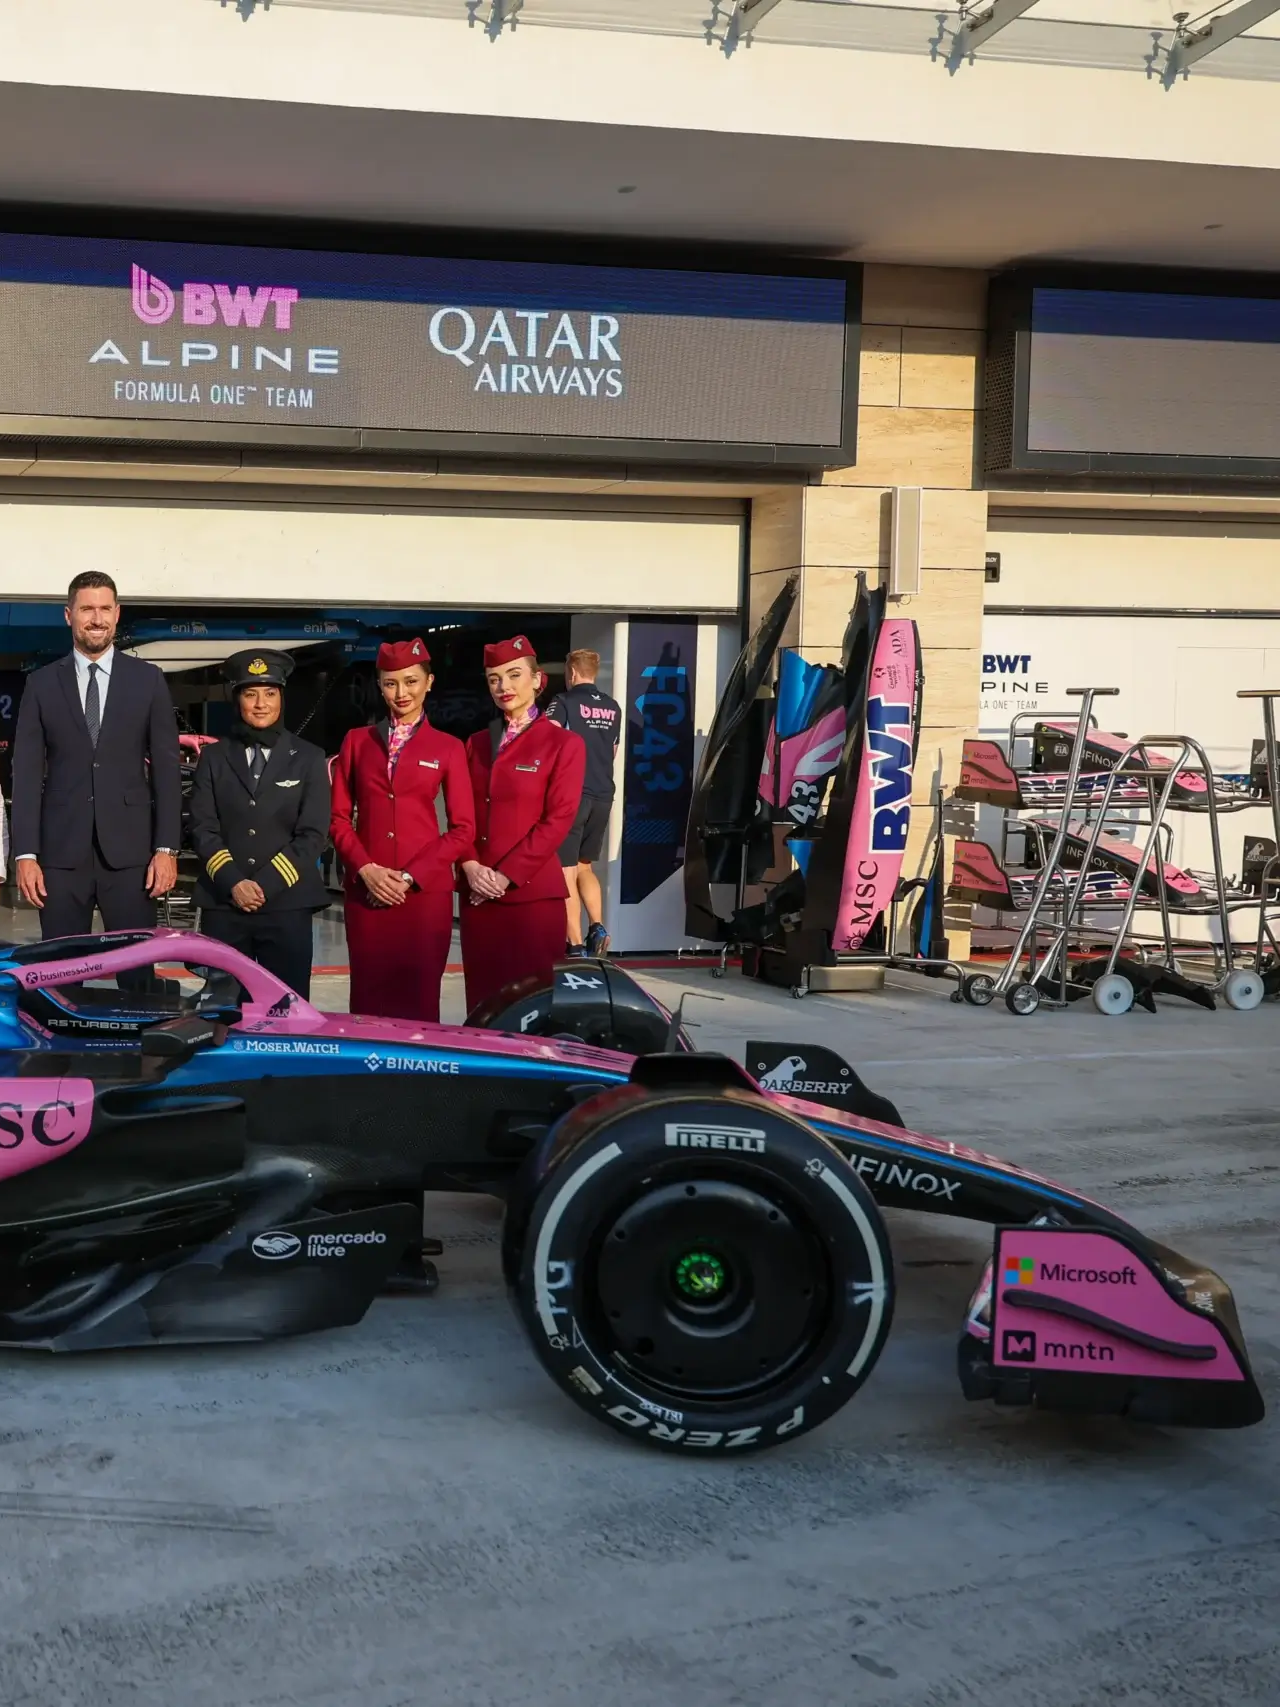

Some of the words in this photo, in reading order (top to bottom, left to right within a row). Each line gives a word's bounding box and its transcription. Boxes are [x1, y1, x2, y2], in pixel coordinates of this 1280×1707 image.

[182, 283, 299, 330] BWT
[428, 307, 622, 367] QATAR
[88, 339, 339, 374] ALPINE
[474, 363, 624, 398] AIRWAYS
[114, 381, 201, 404] FORMULA
[265, 386, 314, 408] TEAM
[171, 623, 191, 633] eni
[304, 623, 323, 633] eni
[982, 654, 1032, 674] BWT
[592, 707, 617, 721] BWT
[633, 666, 687, 792] FC43
[866, 694, 913, 854] BWT
[787, 780, 821, 825] 43
[850, 860, 880, 928] MSC
[39, 961, 104, 982] businessolver
[386, 1056, 460, 1075] BINANCE
[760, 1079, 853, 1095] OAKBERRY
[664, 1122, 767, 1154] PIRELLI
[307, 1230, 387, 1245] mercado
[307, 1243, 346, 1258] libre
[1039, 1263, 1137, 1286] Microsoft
[1043, 1340, 1115, 1362] mntn
[606, 1403, 758, 1448] ZERO
